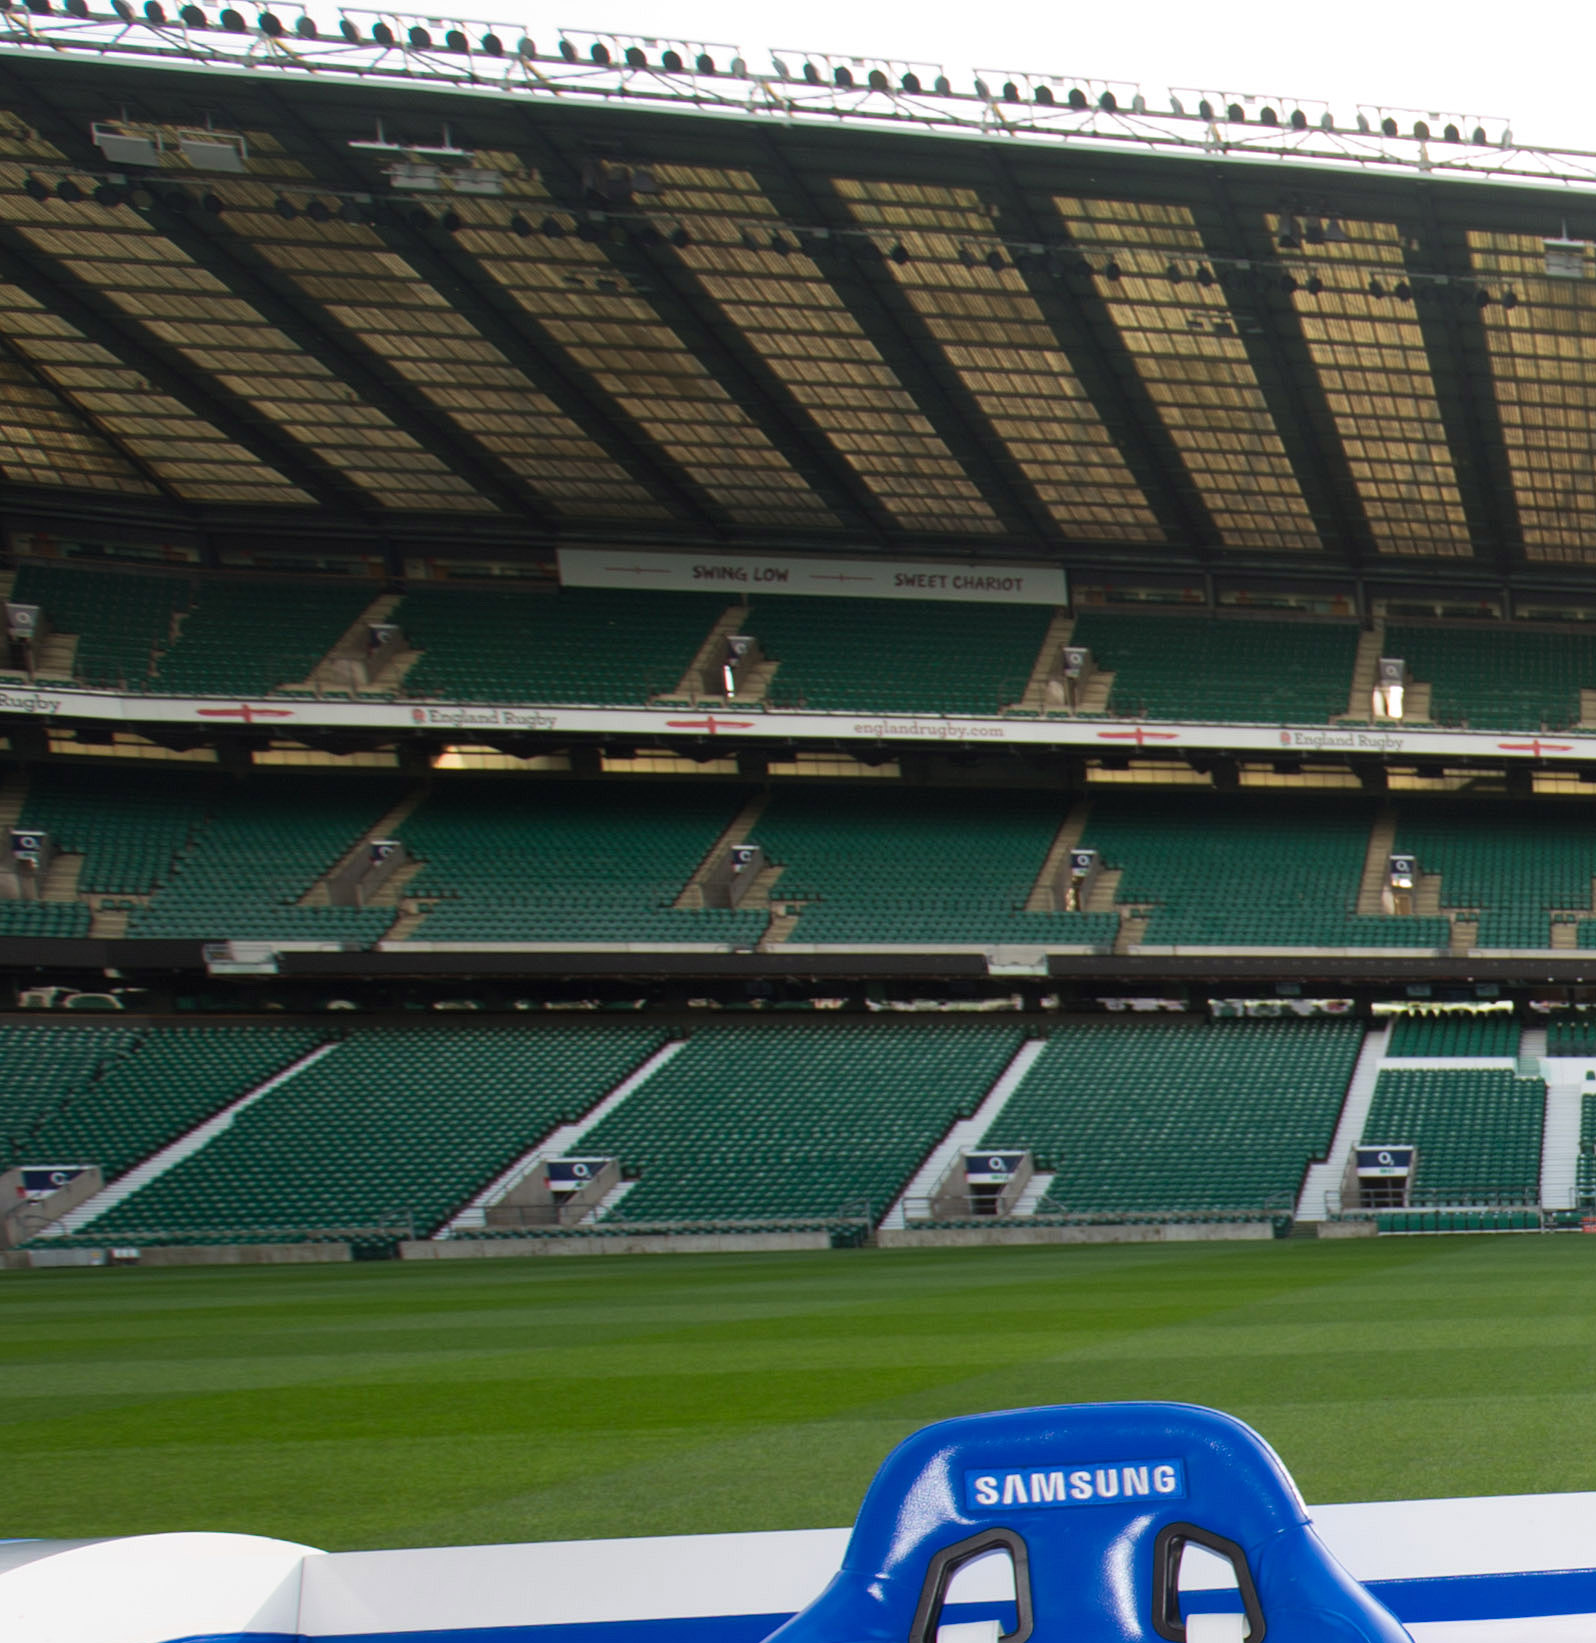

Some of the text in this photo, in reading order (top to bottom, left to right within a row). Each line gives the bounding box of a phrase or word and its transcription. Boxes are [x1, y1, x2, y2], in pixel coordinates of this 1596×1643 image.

[692, 566, 789, 584] SWING LOW
[894, 573, 1024, 591] SWEET CHARIOT
[429, 709, 557, 730] England Rugby
[854, 722, 1004, 738] englandrugby.com
[1294, 735, 1404, 751] England Rugby
[975, 1465, 1176, 1505] SAMSUNG
